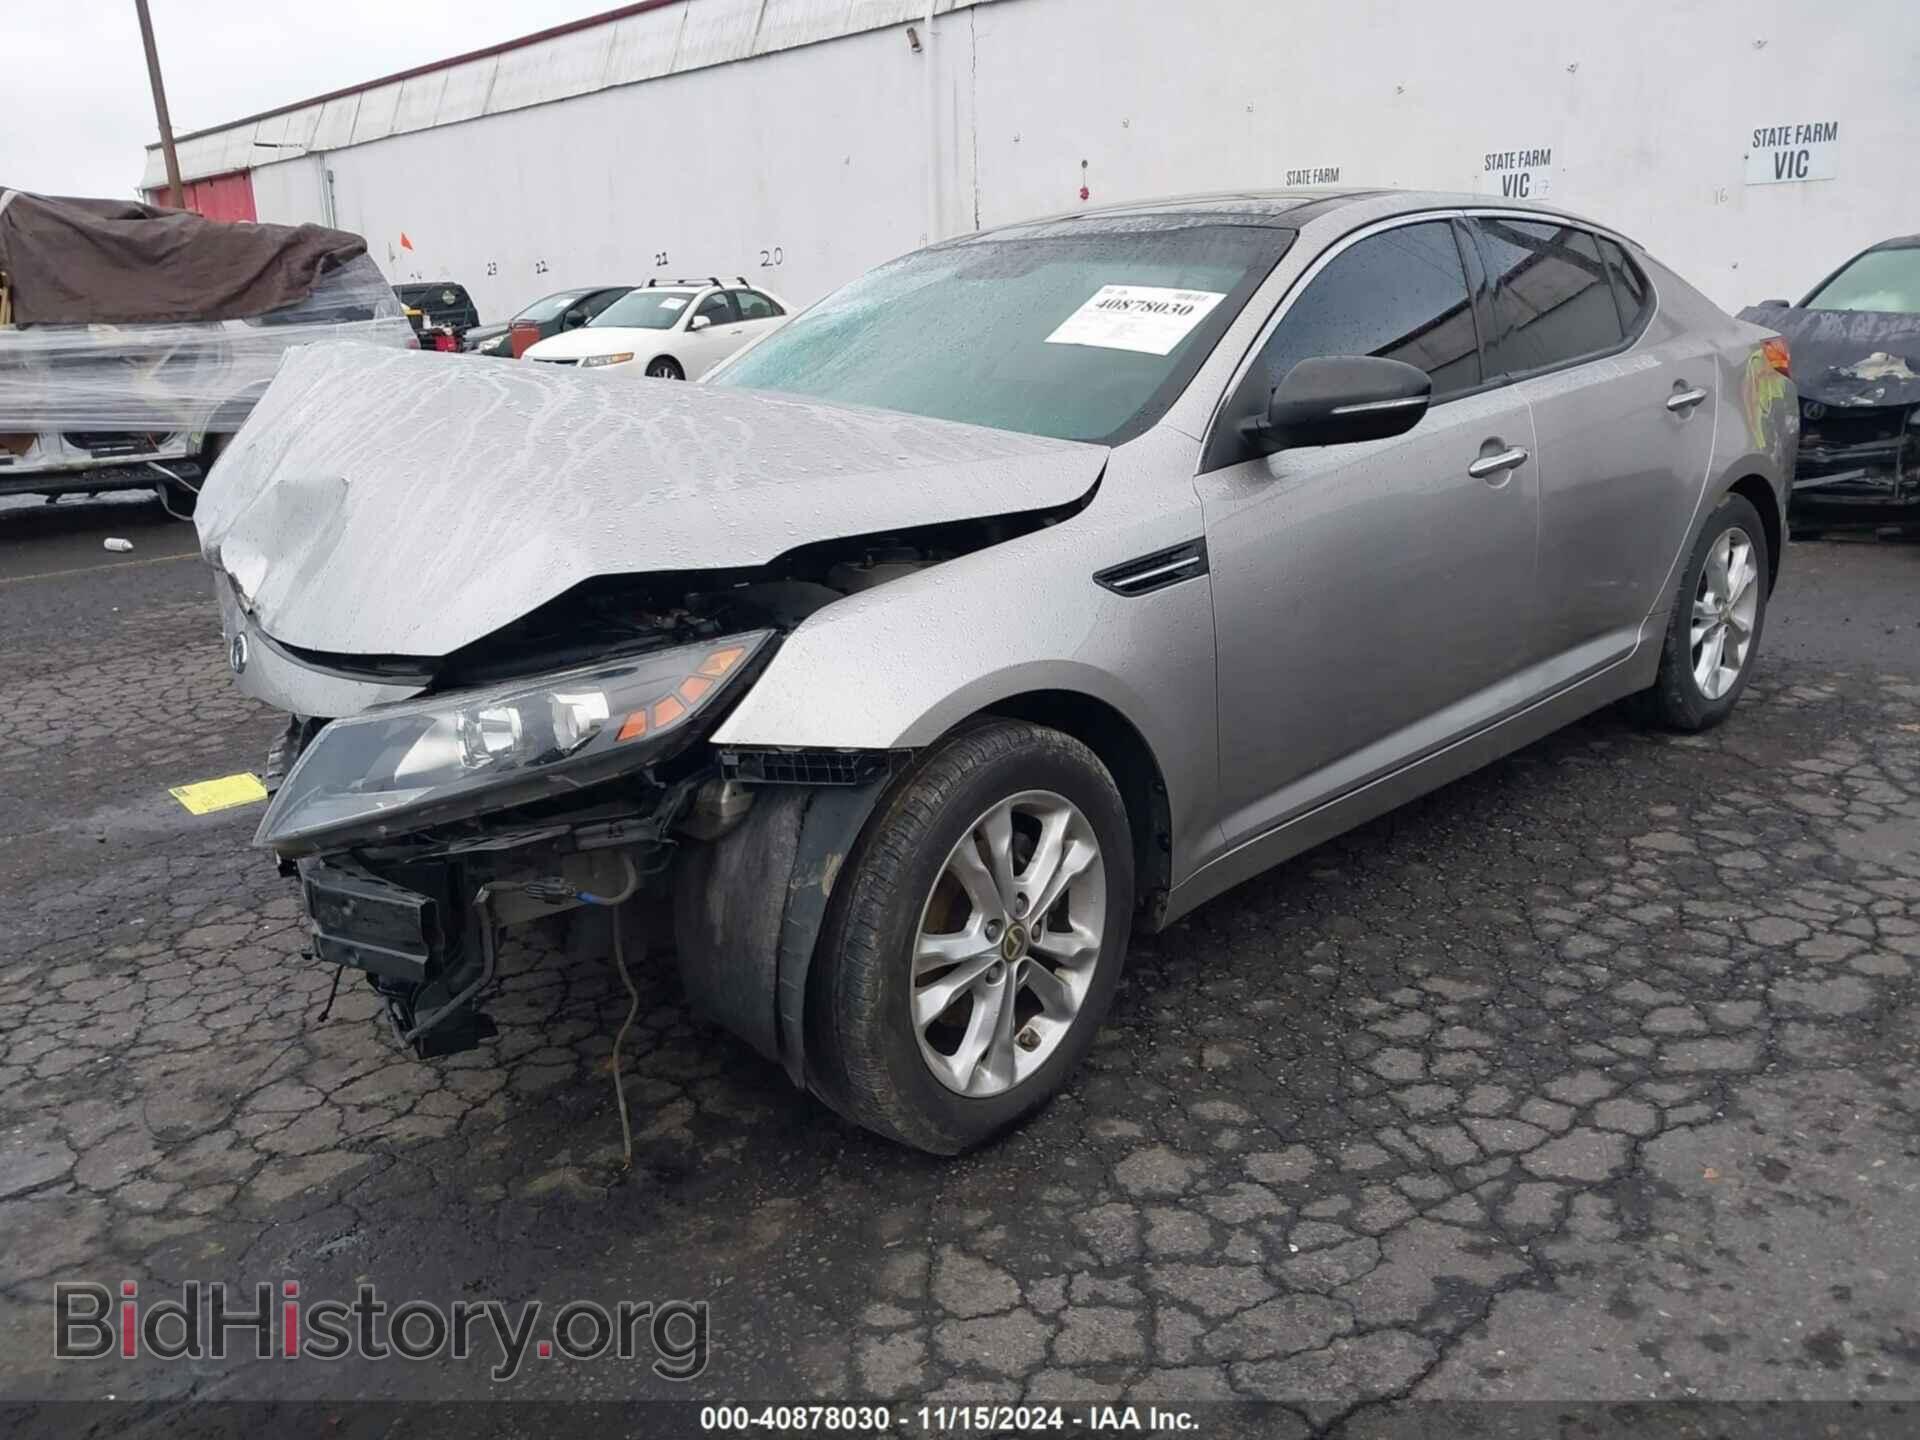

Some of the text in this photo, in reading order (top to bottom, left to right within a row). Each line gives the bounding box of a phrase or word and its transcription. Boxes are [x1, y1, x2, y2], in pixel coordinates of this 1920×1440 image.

[1752, 121, 1838, 148] STATE FARM
[1484, 148, 1551, 171] STATE FARM
[1774, 149, 1810, 180] VIC
[1286, 167, 1340, 186] STATE FARM
[1502, 172, 1530, 198] VIC
[655, 251, 669, 267] 21
[760, 247, 784, 267] 20
[1096, 298, 1195, 316] 40878030
